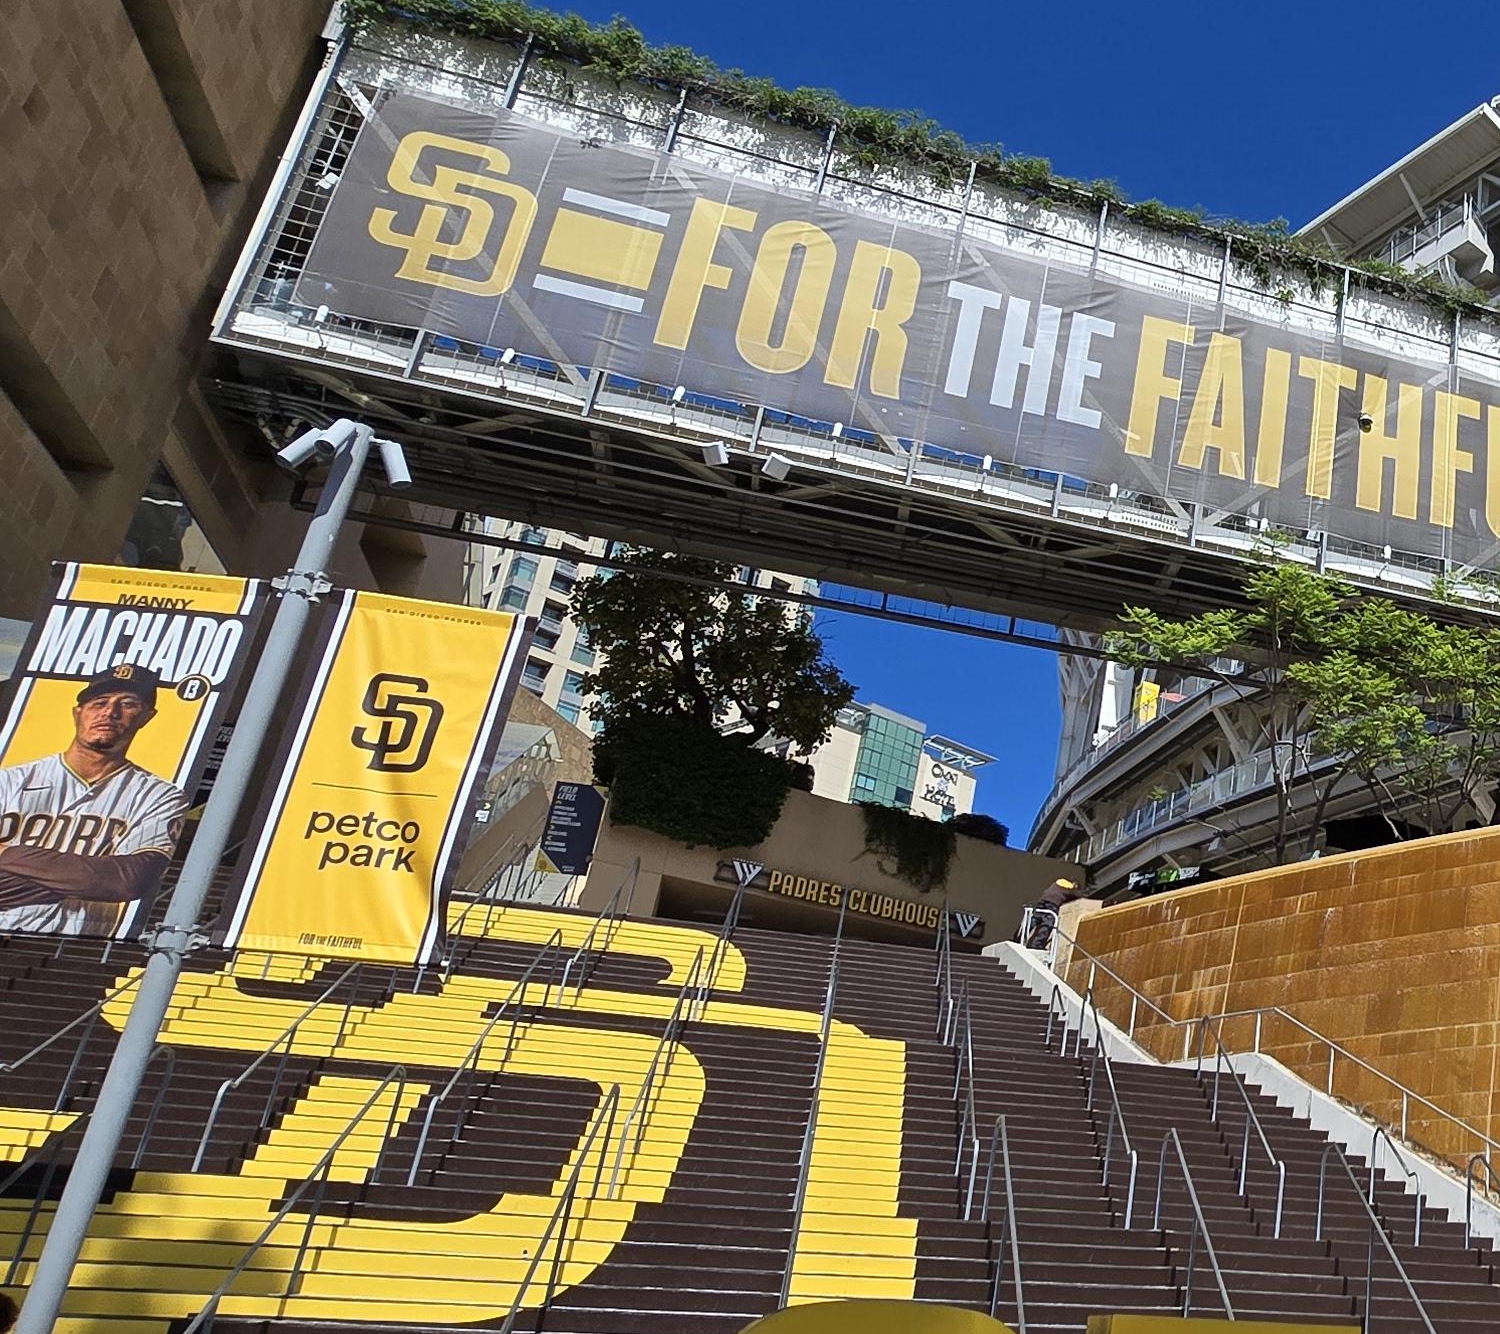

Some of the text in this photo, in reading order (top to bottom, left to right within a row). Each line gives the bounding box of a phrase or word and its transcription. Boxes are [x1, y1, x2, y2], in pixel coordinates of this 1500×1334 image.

[653, 196, 924, 400] FOR
[944, 280, 1116, 430] THE
[117, 593, 195, 610] MANNY
[26, 604, 245, 687] MACHADO
[304, 808, 421, 845] petco
[318, 840, 417, 873] park
[768, 870, 842, 907] PADRES
[298, 932, 316, 945] FOR
[327, 935, 364, 950] FAITHFUL
